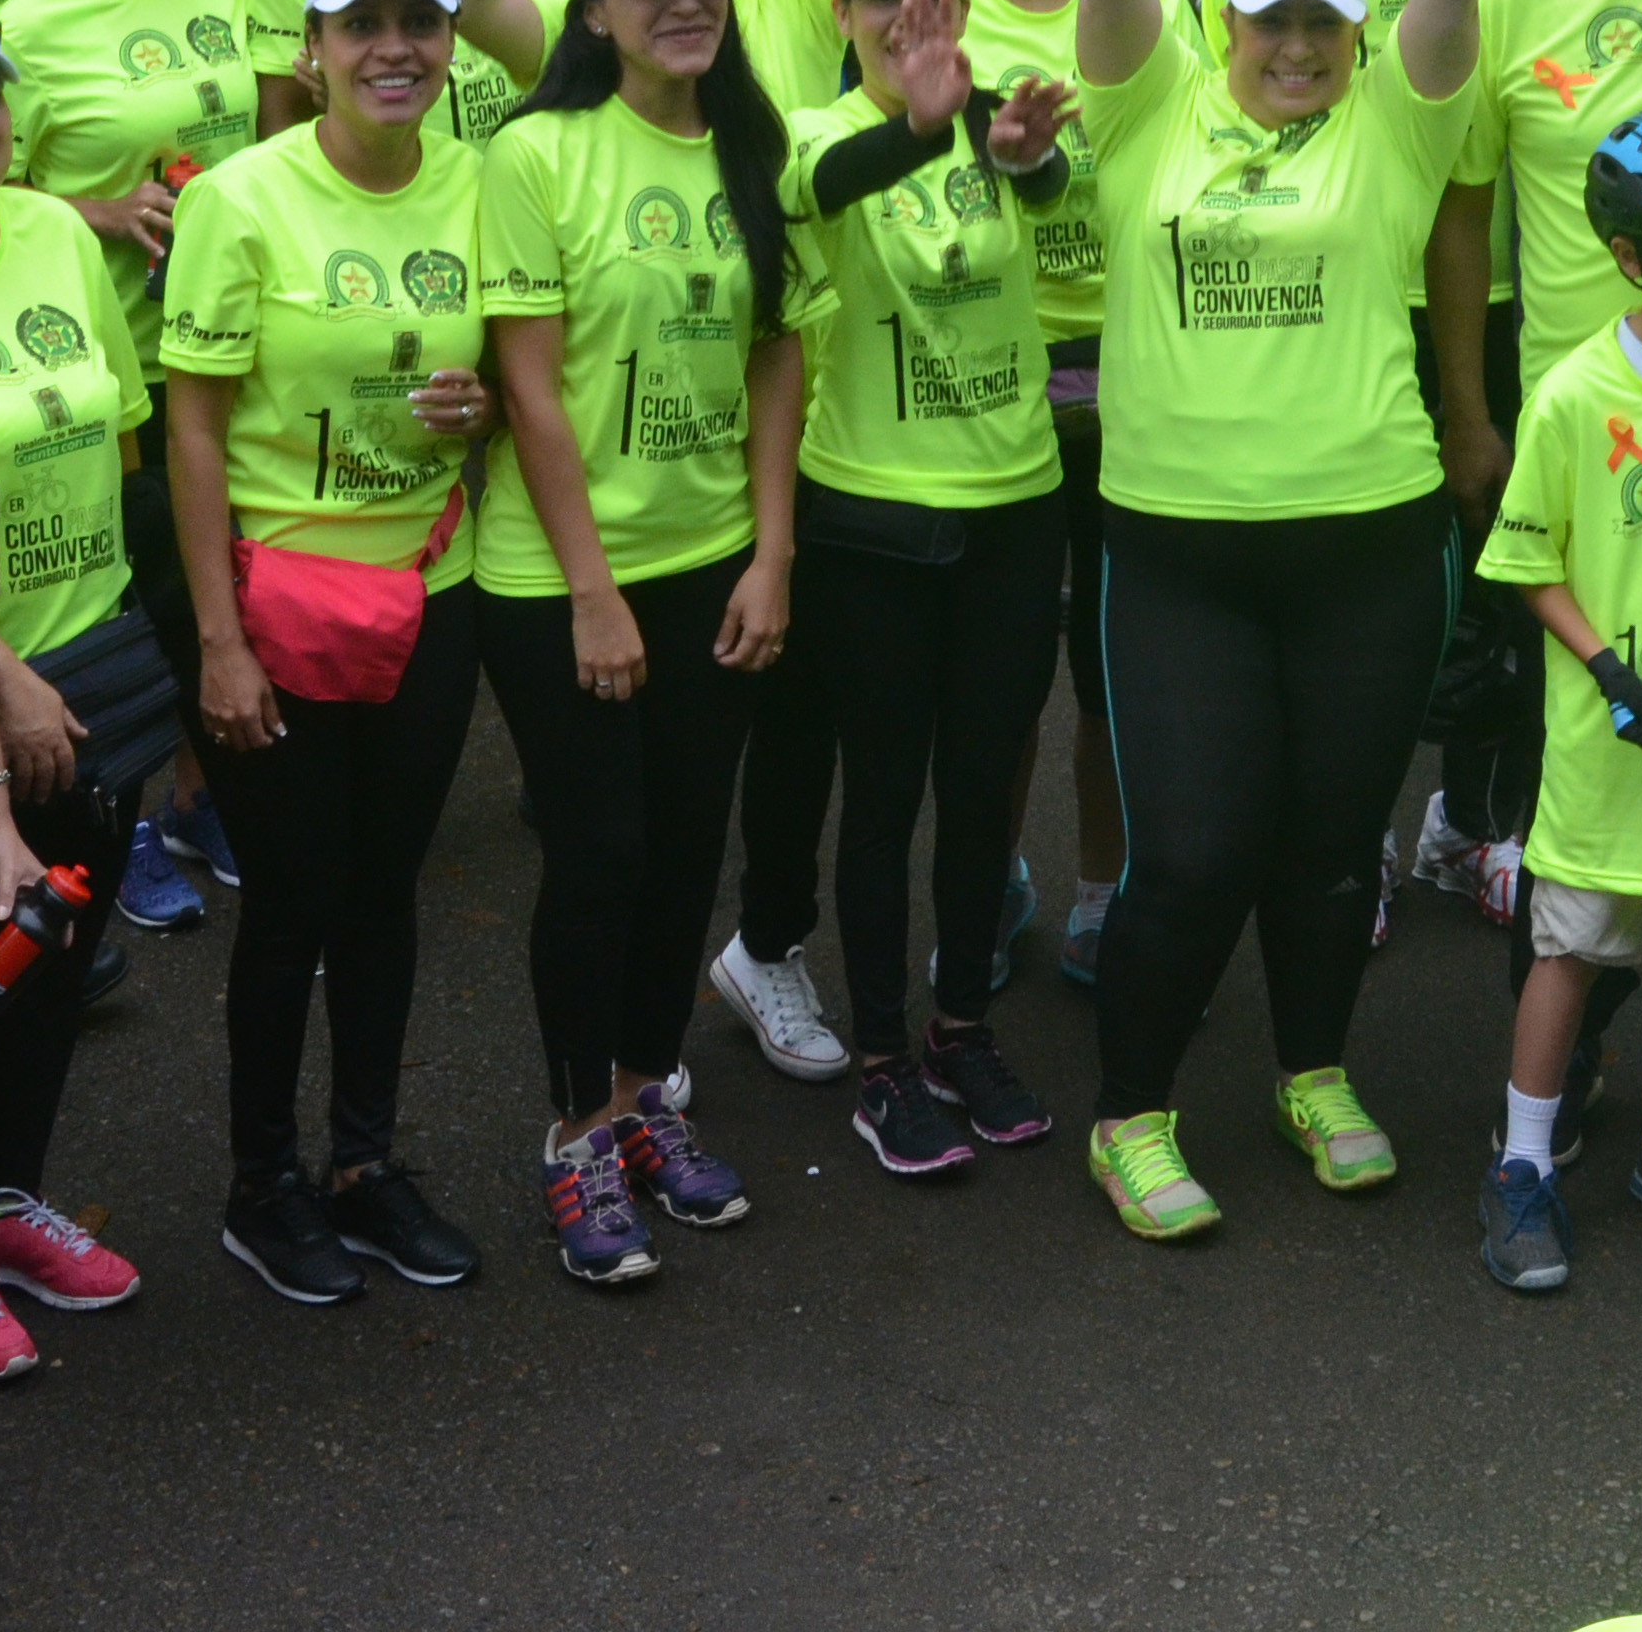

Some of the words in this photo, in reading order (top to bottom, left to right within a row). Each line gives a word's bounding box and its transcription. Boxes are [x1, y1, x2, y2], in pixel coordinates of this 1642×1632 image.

[462, 76, 507, 105] CICLO
[466, 94, 527, 128] CONVIVE
[1033, 220, 1088, 248] CICLO
[1036, 241, 1104, 272] CONVIV
[1160, 215, 1187, 330] 1
[1192, 239, 1208, 253] ER
[1191, 260, 1250, 287] CICLO
[1193, 284, 1325, 315] CONVIVENCIA
[1193, 316, 1202, 330] Y
[1203, 313, 1262, 331] SEGURIDAD
[1263, 311, 1325, 330] CIUDADANA
[876, 311, 907, 423] 1
[912, 334, 928, 349] ER
[614, 349, 639, 457] 1
[648, 372, 664, 387] ER
[640, 394, 693, 422] CICLO
[13, 435, 50, 453] Alcaldía
[58, 442, 82, 459] con
[83, 433, 105, 453] vos
[304, 407, 331, 501] 1
[341, 430, 355, 445] ER
[8, 498, 25, 514] ER
[4, 513, 64, 551] CICLO
[18, 566, 77, 594] SEGURIDAD
